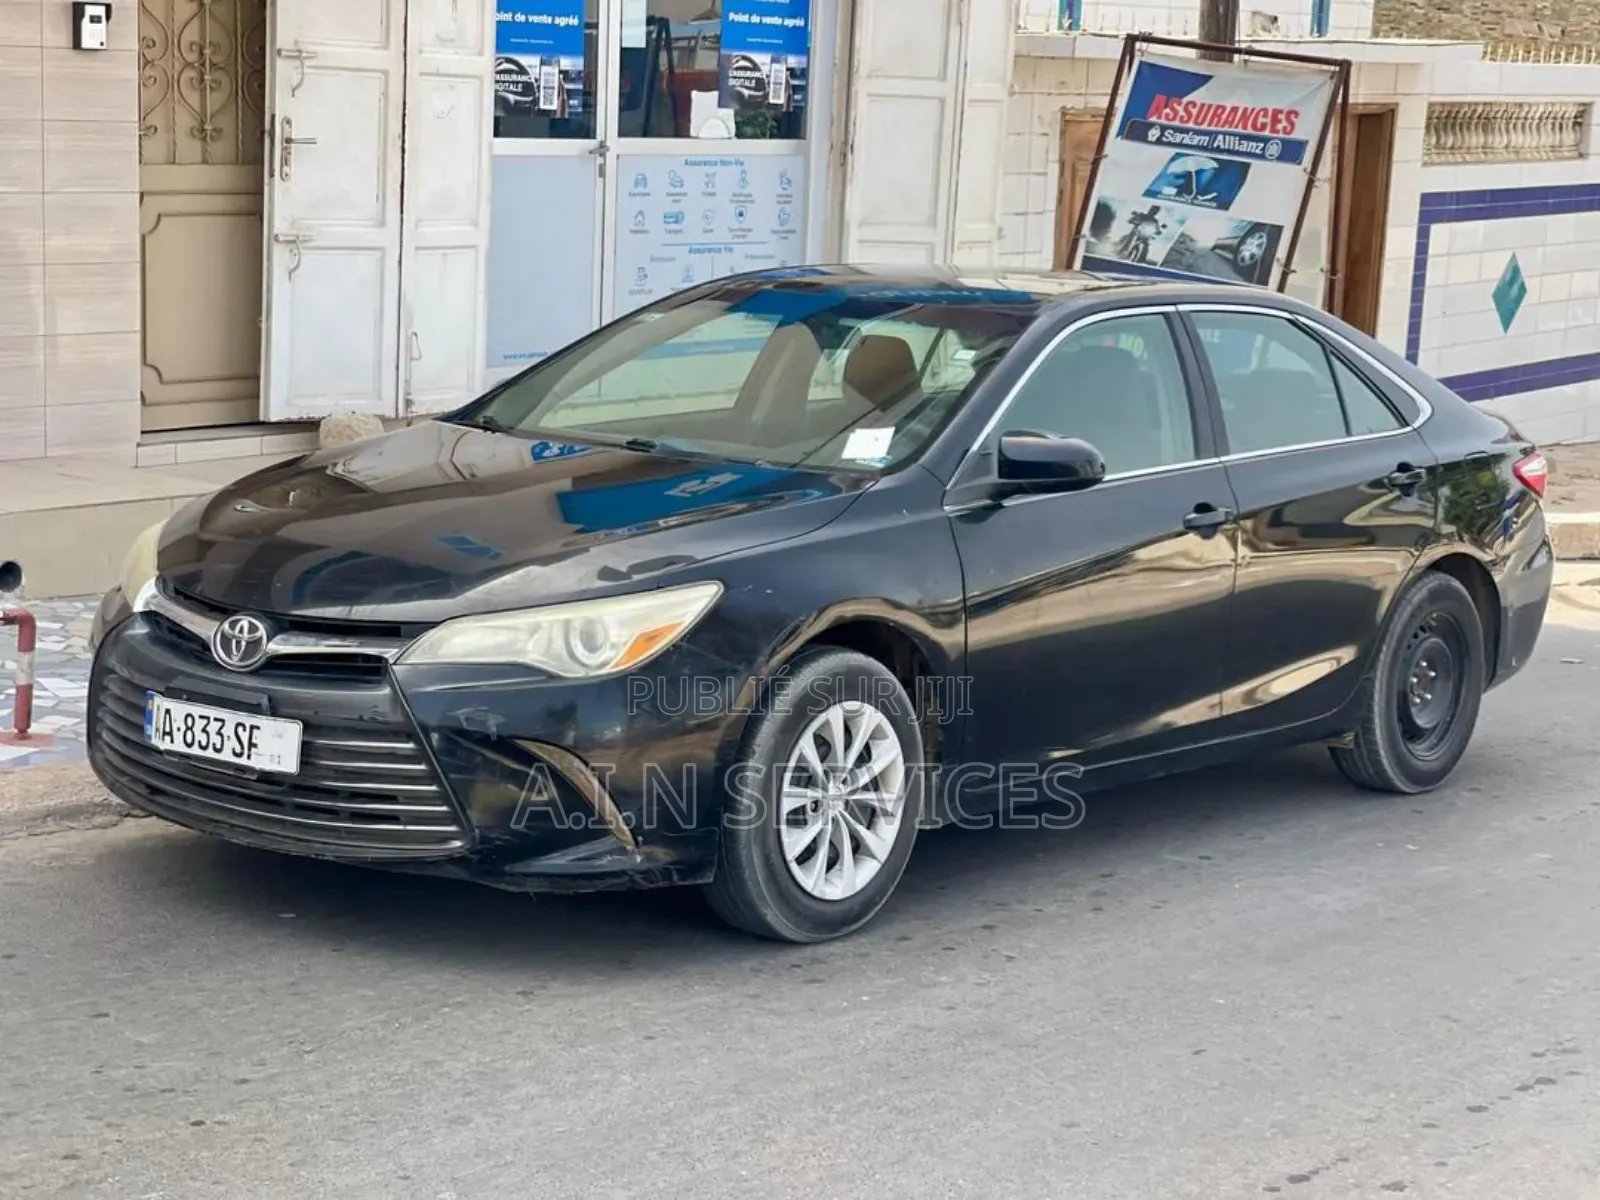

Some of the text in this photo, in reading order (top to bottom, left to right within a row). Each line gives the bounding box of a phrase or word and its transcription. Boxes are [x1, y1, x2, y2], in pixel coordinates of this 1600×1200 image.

[495, 11, 579, 28] oint de vente agréé
[729, 12, 749, 23] Point
[751, 13, 761, 24] de
[762, 15, 782, 26] vente
[728, 78, 756, 87] DIGITALE
[1147, 94, 1300, 136] ASSURANCES
[1162, 129, 1265, 155] Sanlam Allianz
[684, 158, 718, 167] Assurance
[688, 246, 722, 255] Assurance
